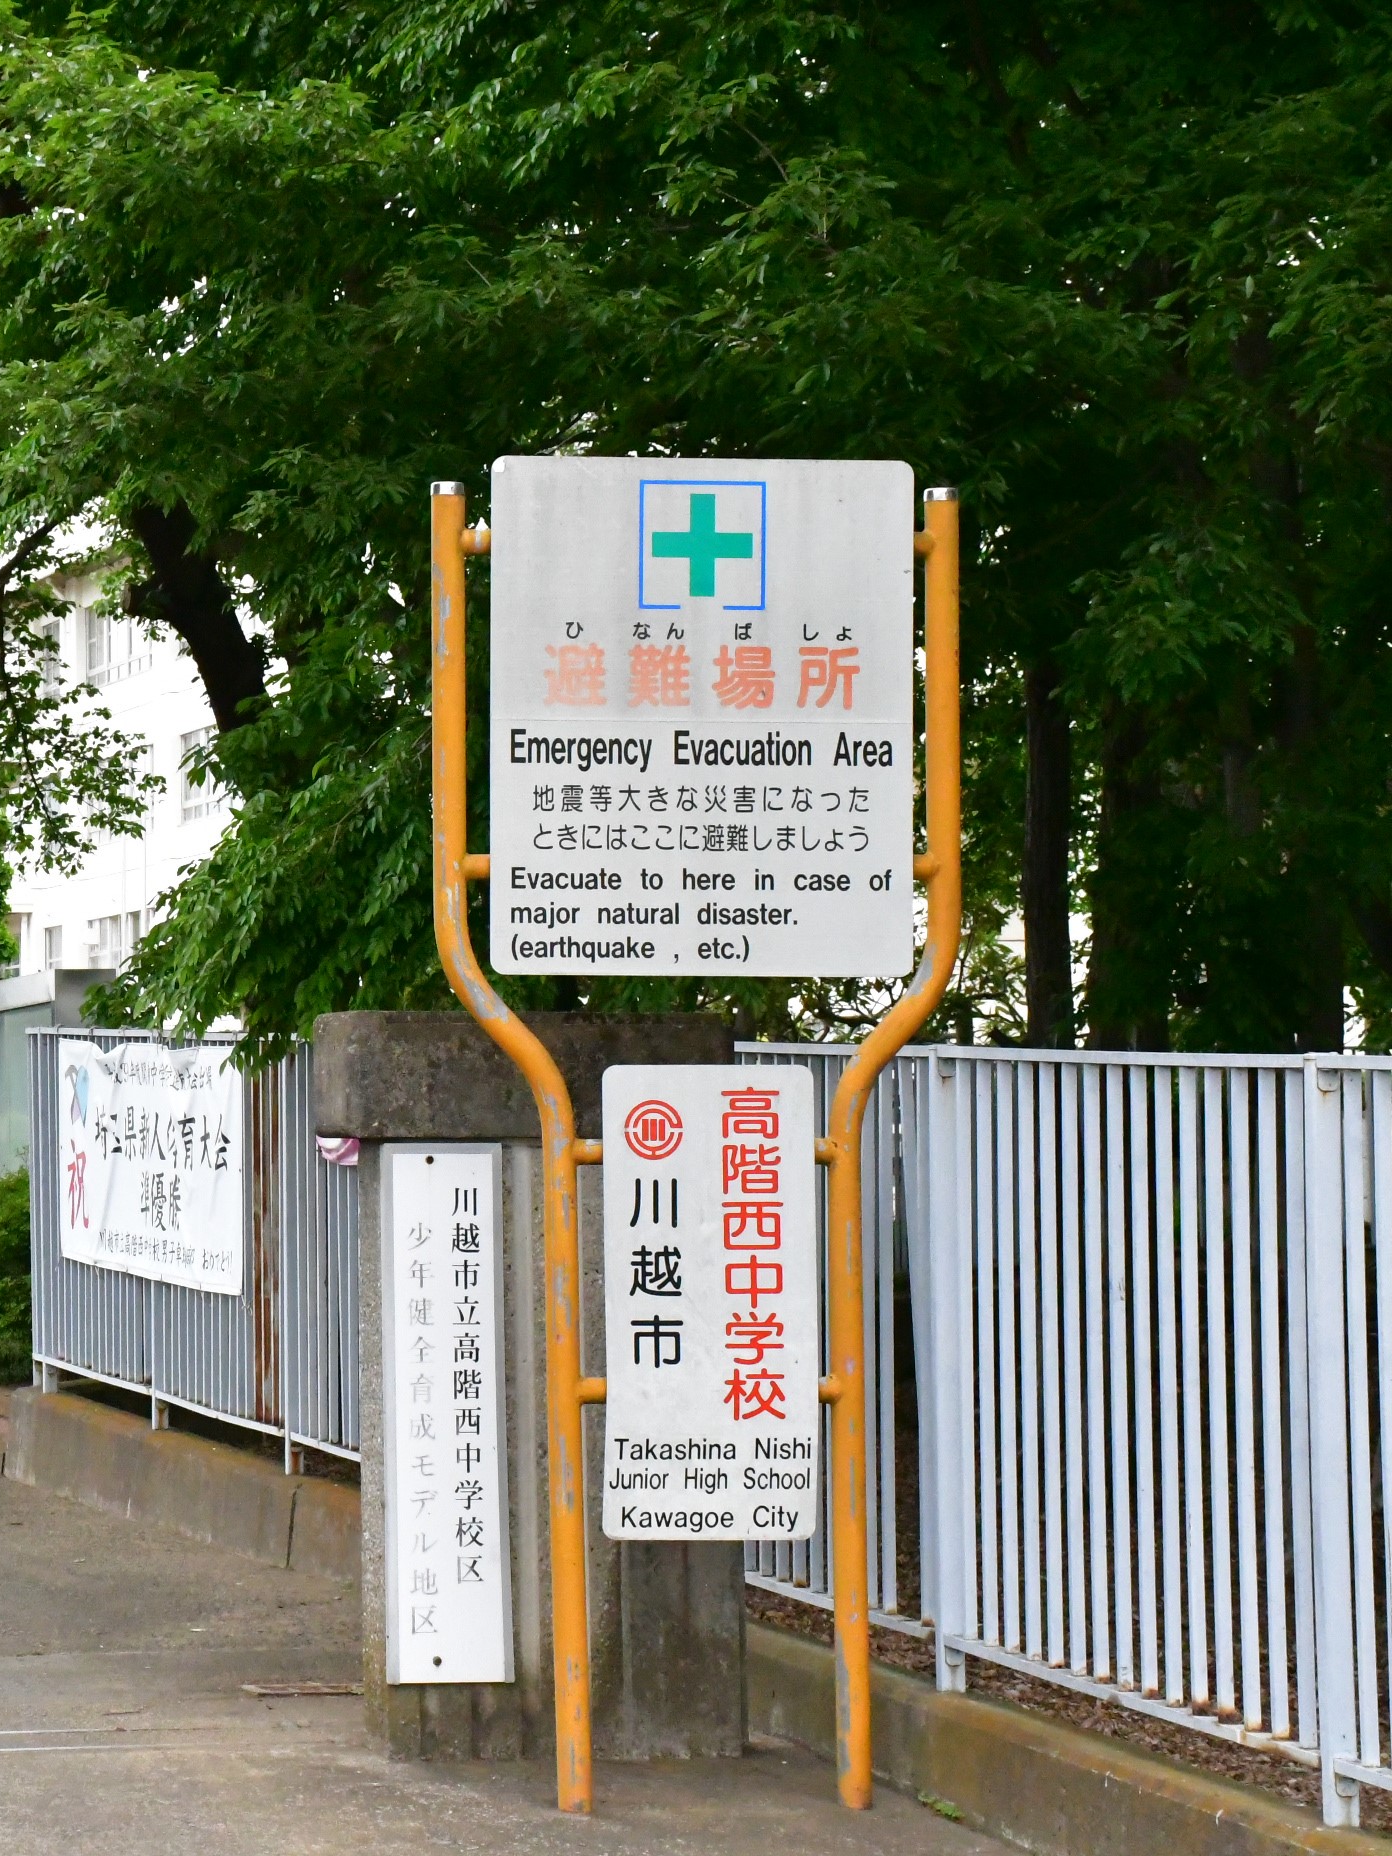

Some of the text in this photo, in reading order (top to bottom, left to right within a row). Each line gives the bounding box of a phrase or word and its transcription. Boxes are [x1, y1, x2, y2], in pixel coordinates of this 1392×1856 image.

[541, 641, 860, 708] 避難場所
[510, 728, 892, 772] Emergency Evacuation Area
[533, 784, 868, 812] 地震等大きな災害になった
[533, 824, 868, 851] ときにはここに避難しましょう
[511, 866, 891, 891] Evacuate to here in case of
[510, 901, 797, 928] major natural disaster.
[697, 935, 749, 962] etc.)
[66, 1139, 87, 1228] 祝
[139, 1170, 179, 1230] 準優勝
[719, 1085, 784, 1419] 高階西中学校
[629, 1178, 683, 1368] 川越市
[451, 1187, 483, 1584] 川越市立高階西中学校区
[406, 1220, 438, 1635] 少年健全育成モデル地区
[614, 1437, 810, 1460] Takashina Nishi
[609, 1466, 809, 1494] Junior High School
[621, 1505, 797, 1532] Kawagoe City
